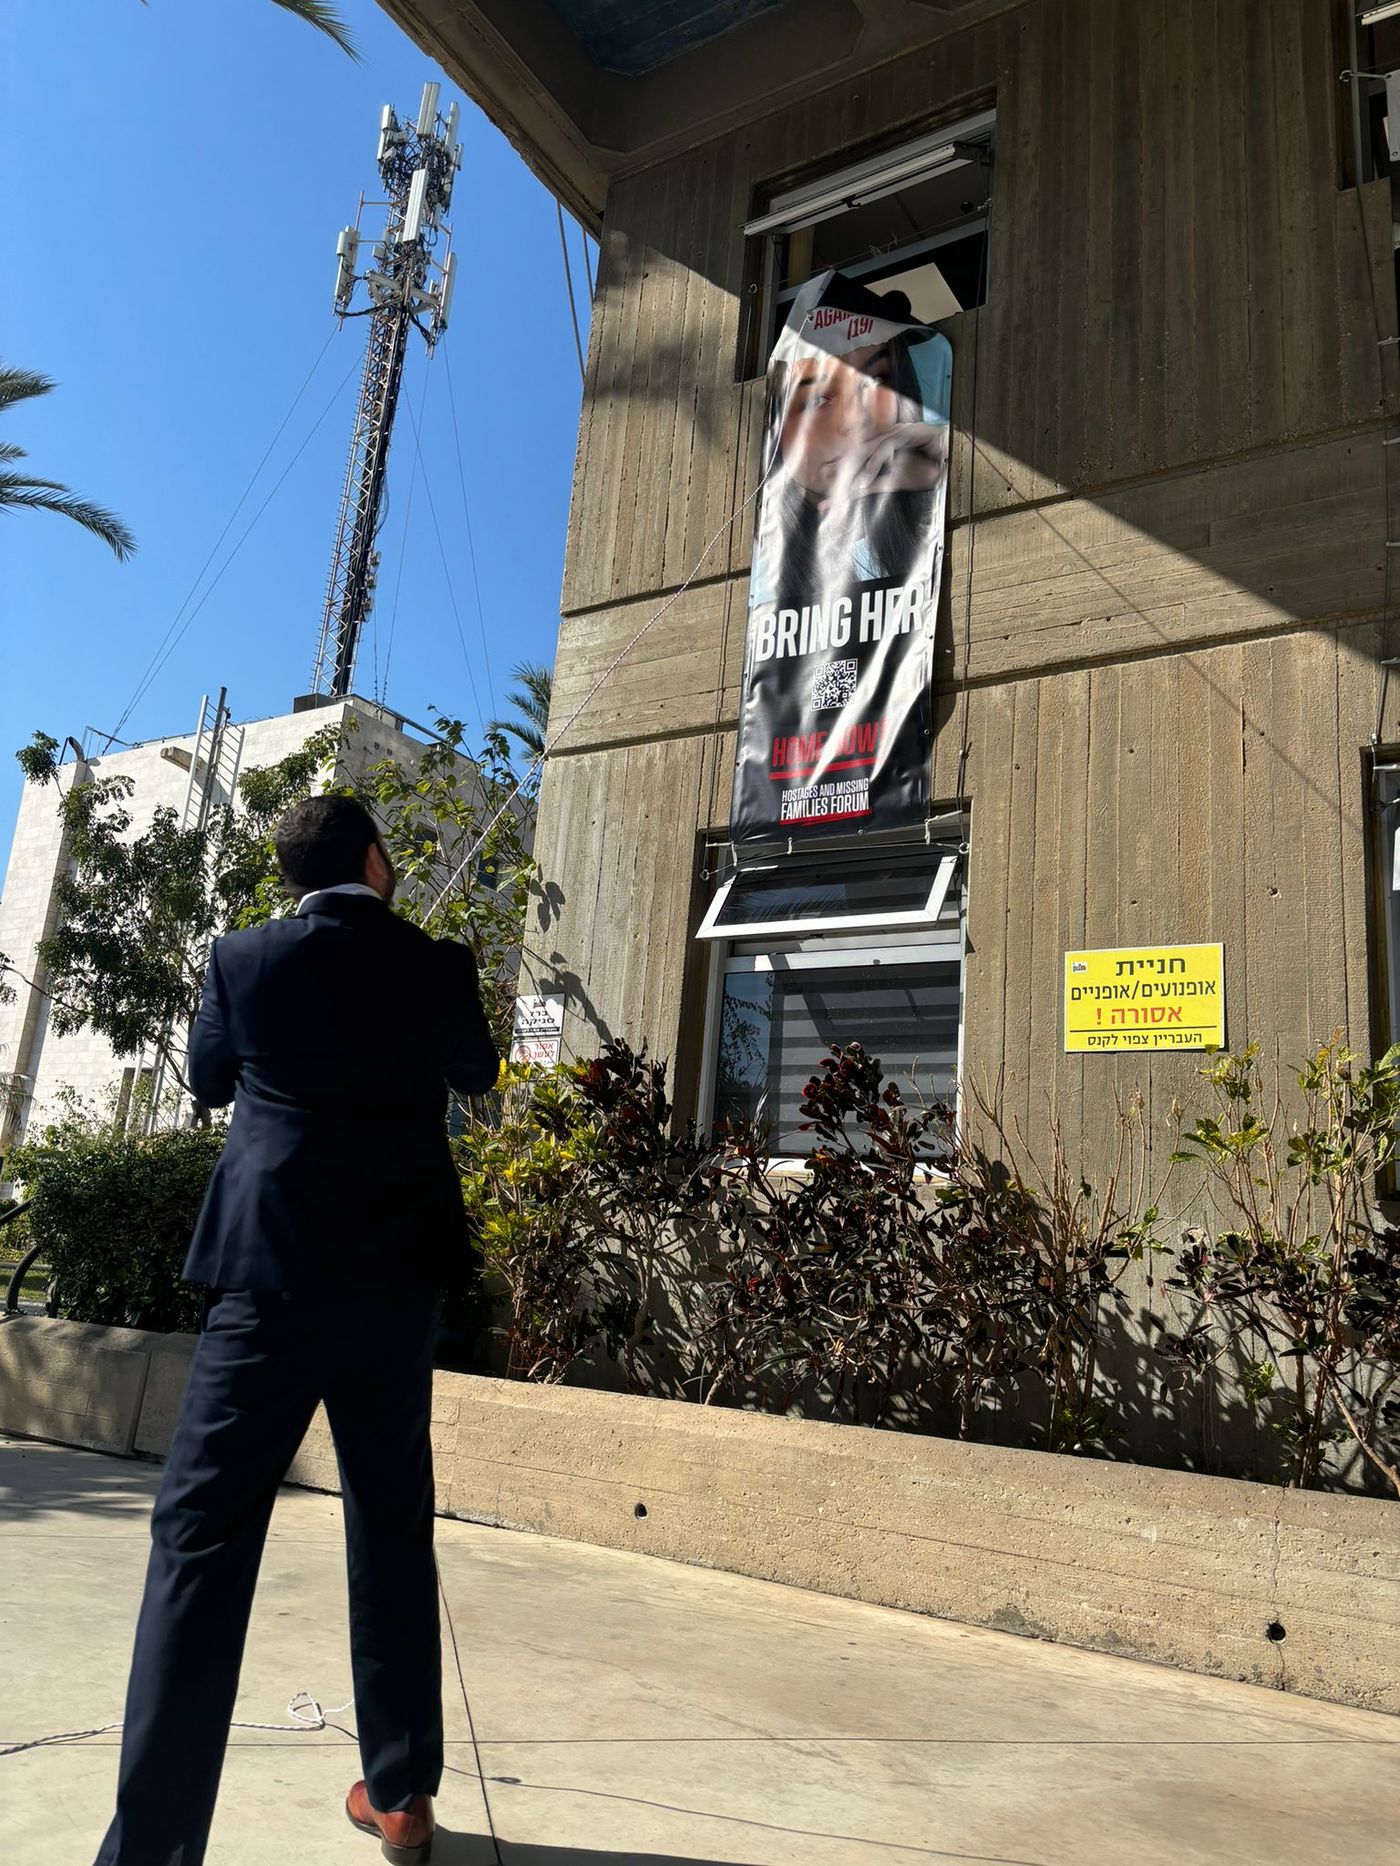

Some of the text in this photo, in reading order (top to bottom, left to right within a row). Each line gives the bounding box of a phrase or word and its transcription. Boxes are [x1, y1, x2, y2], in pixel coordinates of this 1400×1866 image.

[755, 582, 924, 663] BRING HER
[781, 778, 869, 802] HOSTAGES AND MISSING
[780, 791, 869, 820] FAMILIES FORUM
[1115, 957, 1186, 976] חניית
[1111, 1006, 1183, 1025] אסורה
[1087, 1033, 1202, 1048] העבריין צפוי לקנס
